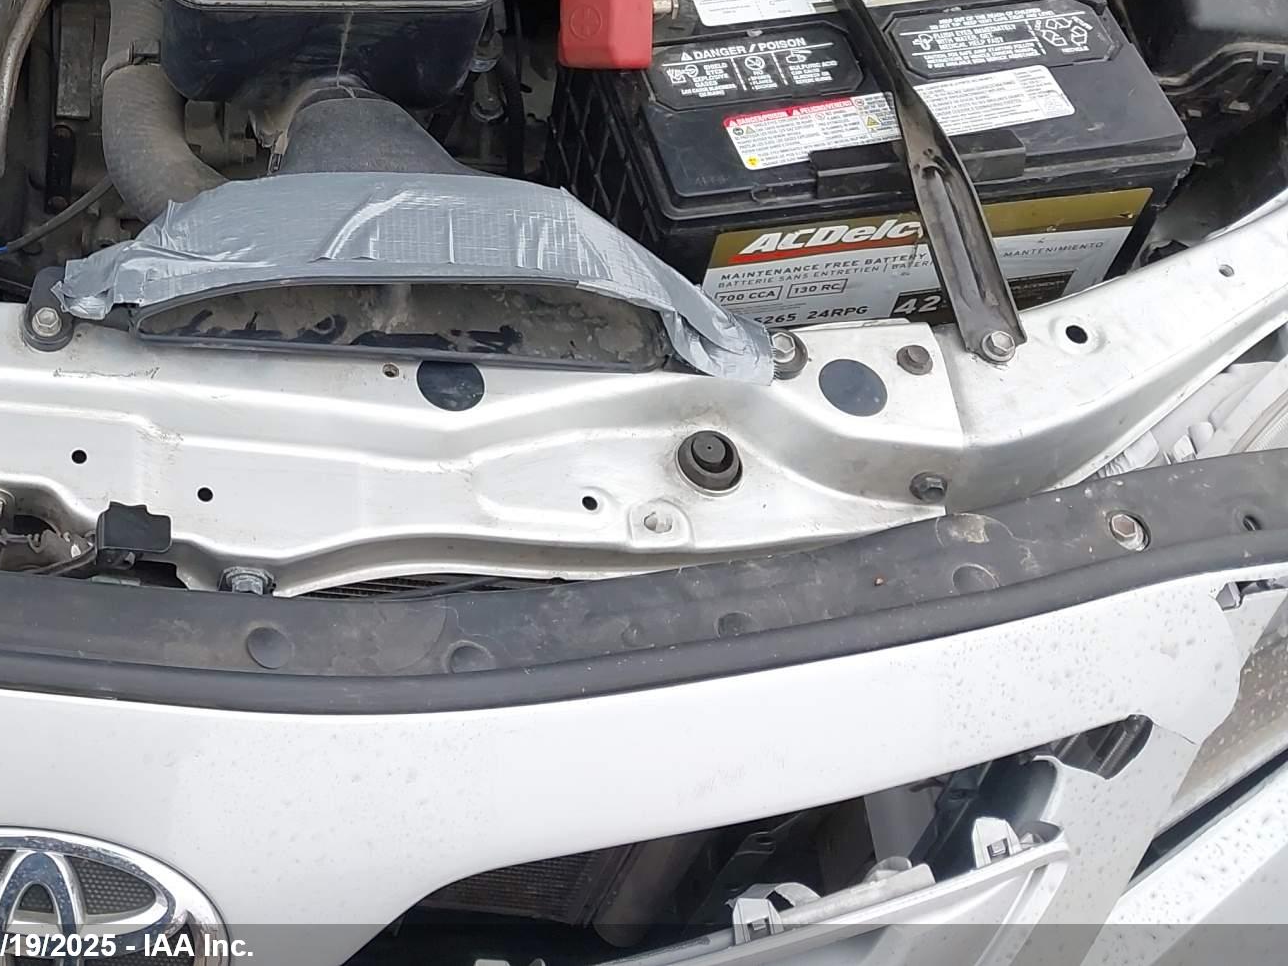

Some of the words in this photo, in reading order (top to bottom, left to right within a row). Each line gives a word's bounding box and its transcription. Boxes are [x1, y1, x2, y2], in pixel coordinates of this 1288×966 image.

[693, 44, 747, 61] DANGER
[759, 37, 807, 52] POISON
[718, 276, 775, 289] BATTERIE
[779, 271, 810, 282] SANS
[813, 264, 880, 278] ENTRETIEN
[1003, 241, 1104, 258] MANTENIMIENTO
[720, 263, 820, 281] MAINTENANCE
[824, 259, 860, 270] FREE
[864, 252, 928, 265] BATTERY
[719, 291, 745, 303] 700
[748, 289, 776, 300] CCA
[793, 284, 817, 294] 130
[820, 281, 841, 291] RC
[806, 305, 869, 320] 24RPG
